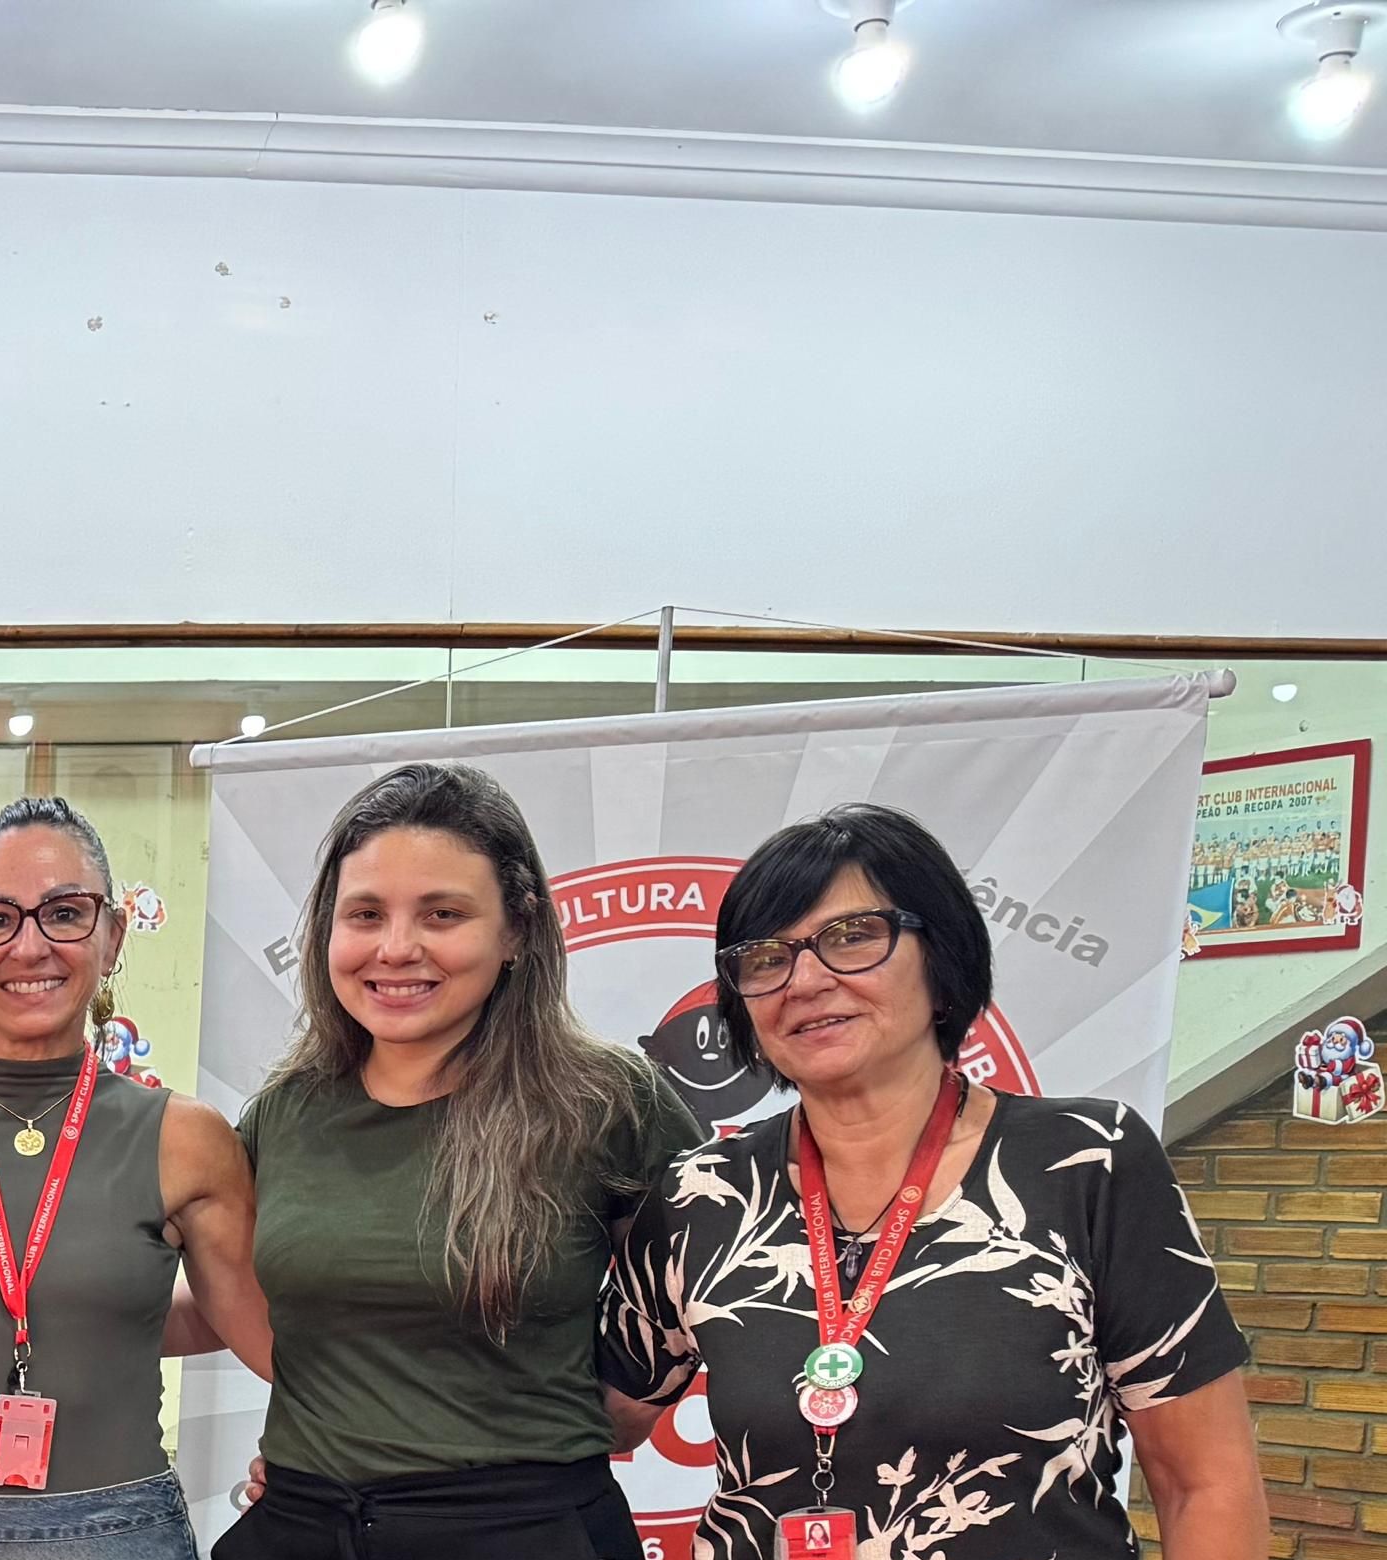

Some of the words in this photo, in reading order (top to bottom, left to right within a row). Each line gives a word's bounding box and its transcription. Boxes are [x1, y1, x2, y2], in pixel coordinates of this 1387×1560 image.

[1214, 790, 1242, 806] CLUB
[1245, 777, 1337, 802] INTERNACIONAL
[1227, 805, 1239, 816] DA
[1244, 798, 1283, 813] RECOPA
[1289, 795, 1313, 808] 2007
[965, 871, 1110, 968] ência
[76, 1073, 91, 1096] CLUB
[71, 1094, 84, 1124] SPORT
[33, 1177, 61, 1244] INTERNACIONAL
[810, 1191, 831, 1290] INTERNACIONAL
[885, 1208, 911, 1247] SPORT
[870, 1248, 893, 1277] CLUB
[822, 1291, 837, 1320] CLUB
